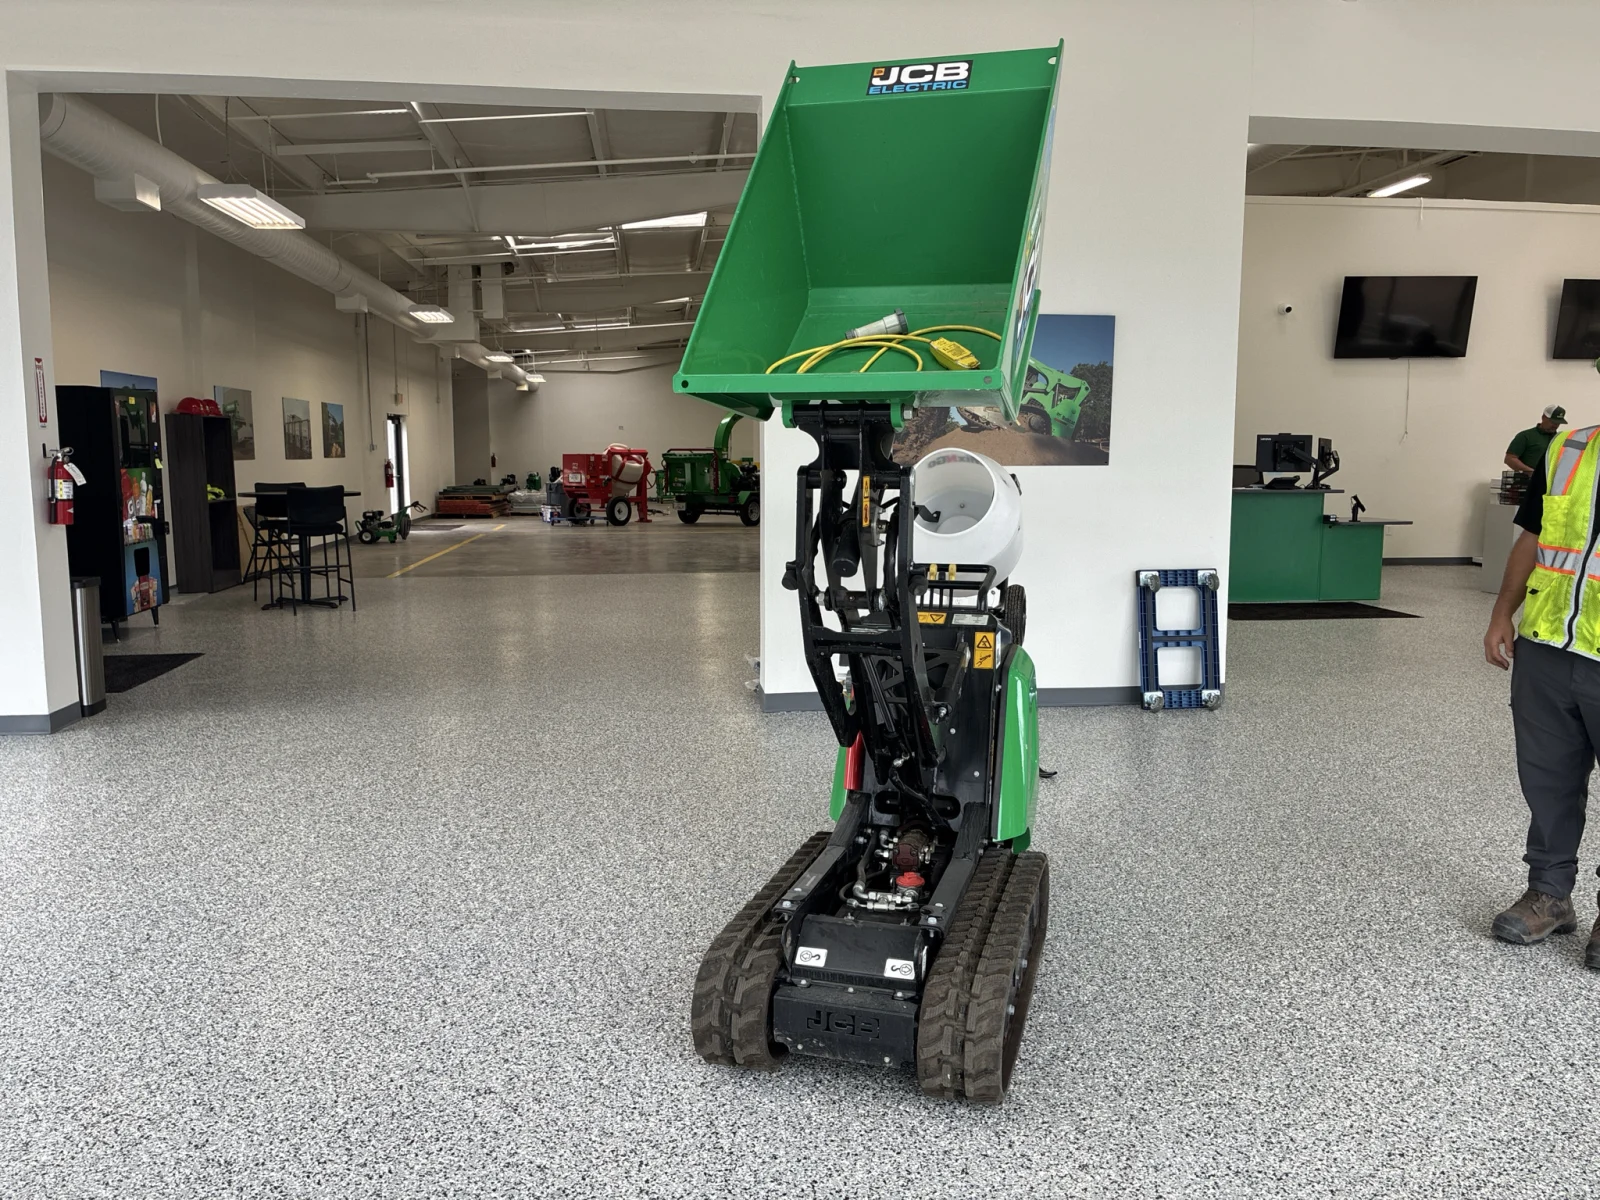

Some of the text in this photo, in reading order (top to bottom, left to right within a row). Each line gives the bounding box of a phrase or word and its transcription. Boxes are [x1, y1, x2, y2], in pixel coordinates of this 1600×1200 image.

[871, 62, 970, 86] JCB
[868, 80, 968, 95] ELECTRIC
[806, 1009, 880, 1039] JCB
